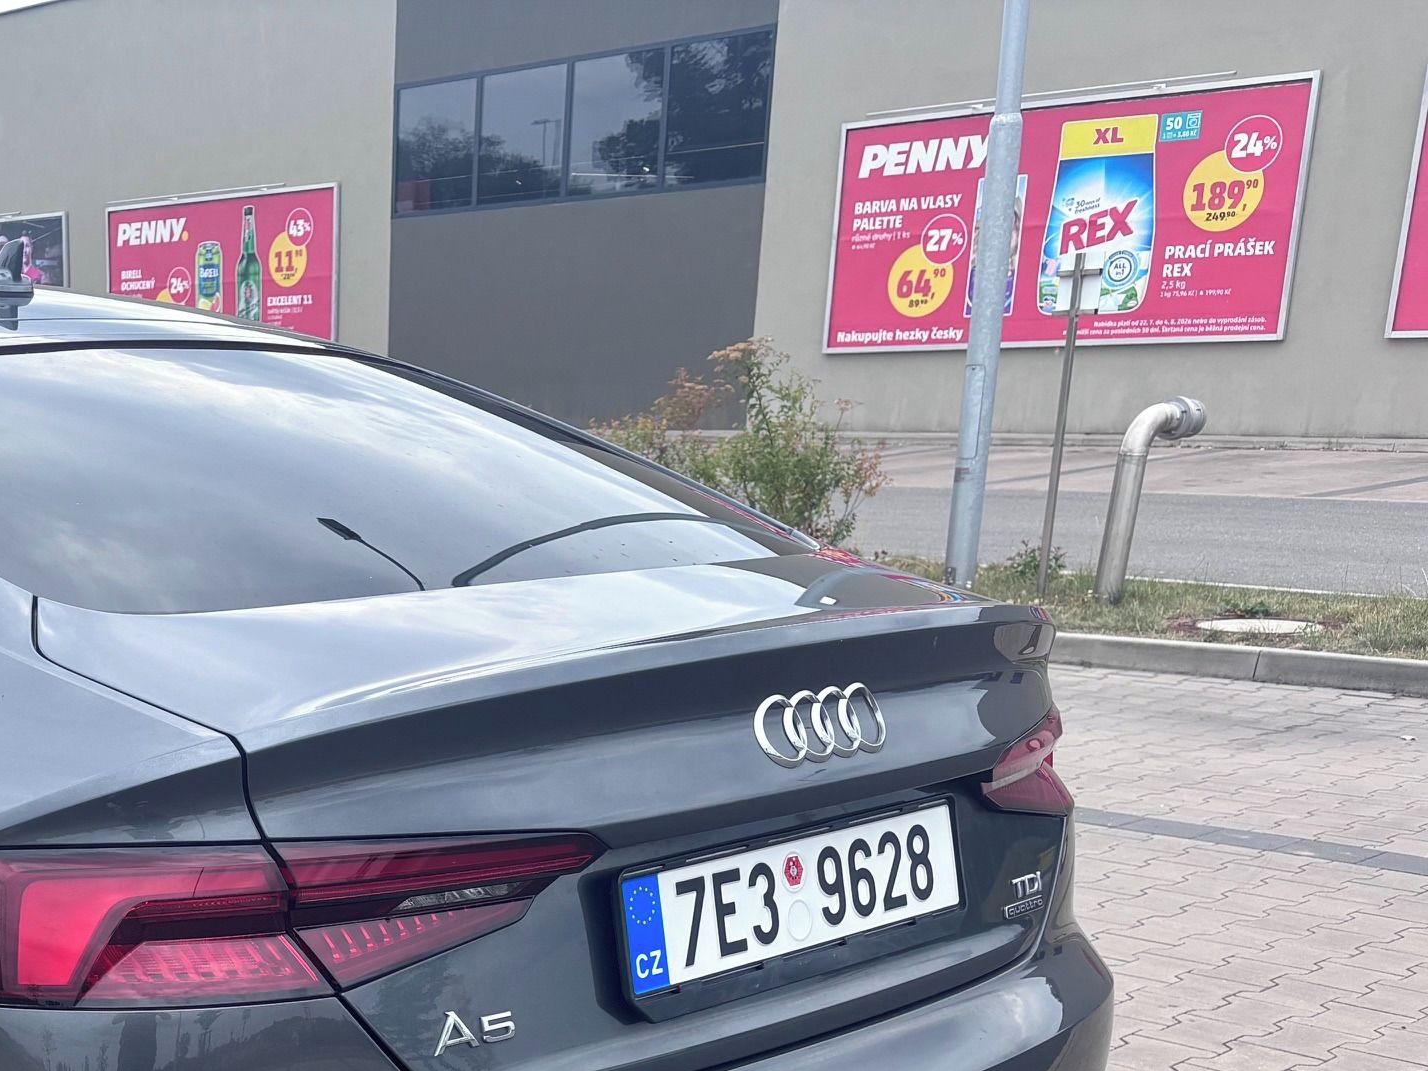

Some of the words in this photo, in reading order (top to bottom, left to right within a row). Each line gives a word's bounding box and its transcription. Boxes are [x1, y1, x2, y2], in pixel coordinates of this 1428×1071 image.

[1166, 117, 1183, 130] 50
[1093, 127, 1124, 145] XL
[1231, 132, 1279, 158] 24%
[854, 199, 897, 215] BARVA
[900, 197, 917, 211] NA
[920, 194, 962, 210] VLASY
[289, 219, 311, 237] 43%
[853, 215, 903, 231] PALETTE
[1059, 199, 1138, 255] REX
[926, 228, 964, 252] 27%
[1164, 239, 1212, 260] PRACÍ
[1213, 237, 1275, 257] PRÁŠEK
[121, 269, 142, 280] BIRELL
[1162, 263, 1193, 277] REX
[121, 277, 155, 292] OCHUCENÝ
[170, 277, 190, 294] 24%
[1161, 281, 1174, 290] 2,5
[1176, 280, 1186, 290] kg
[267, 295, 302, 306] EXCELENT
[303, 294, 312, 305] 11
[1110, 327, 1141, 335] posledních
[1198, 325, 1204, 333] je
[1223, 324, 1250, 333] prodejní
[1117, 319, 1131, 327] platí
[1217, 316, 1247, 325] vyprodání
[837, 328, 893, 344] Nakupujte
[895, 327, 929, 342] hezky
[931, 326, 964, 341] česky
[1012, 871, 1042, 898] TDI
[675, 862, 780, 968] 7E3
[816, 824, 934, 927] 9628
[1009, 898, 1043, 918] quattro
[635, 949, 664, 979] CZ
[434, 1010, 516, 1056] A5
